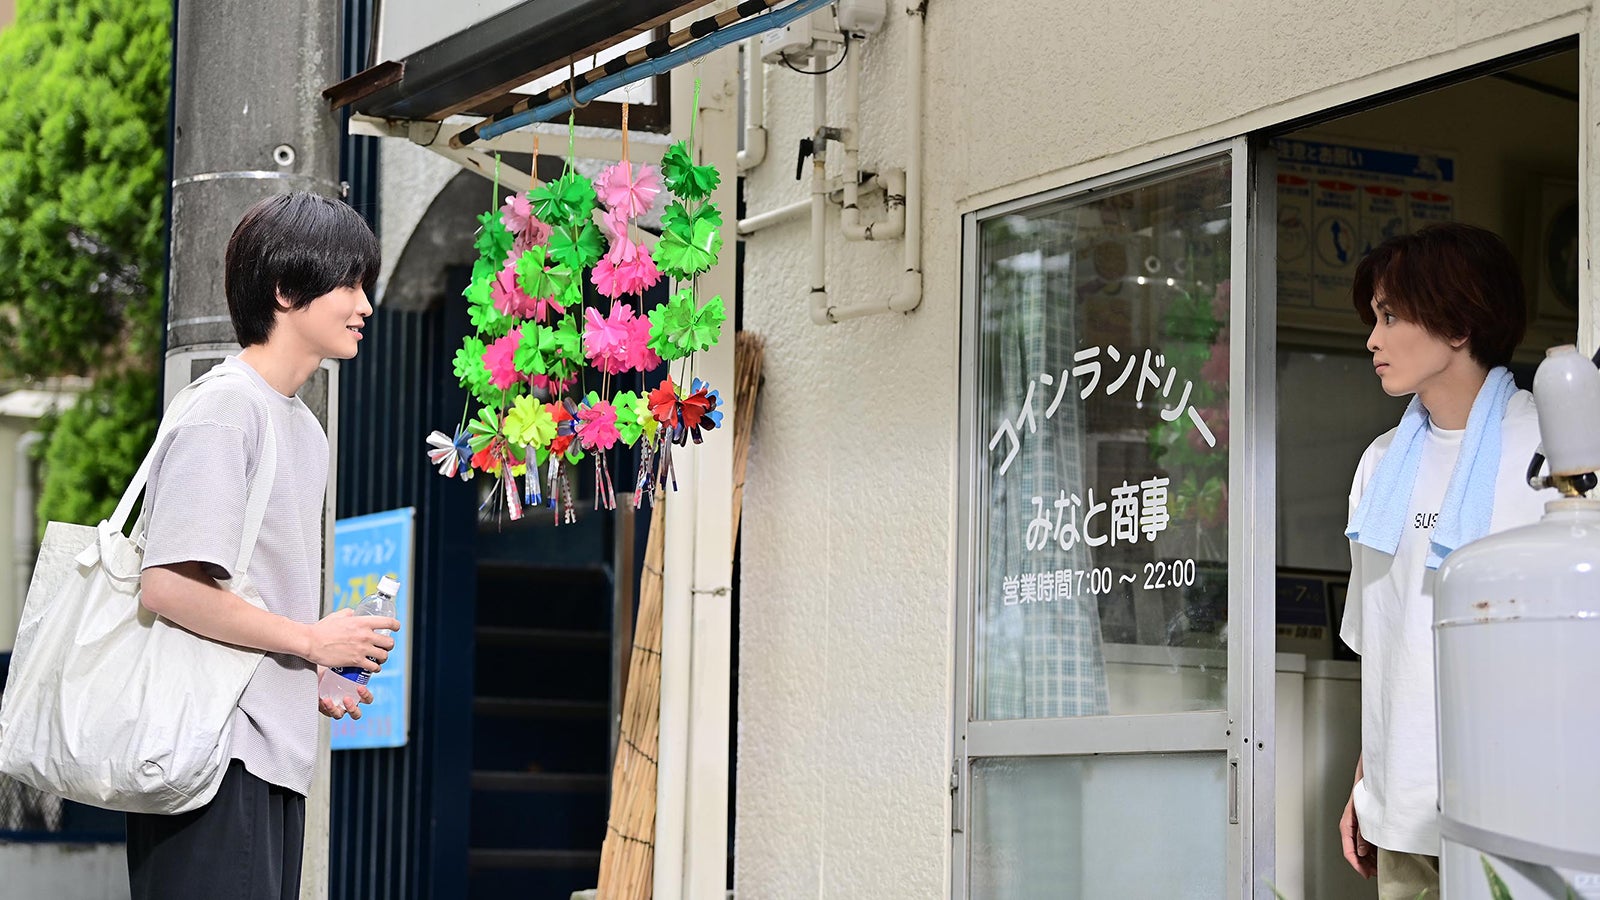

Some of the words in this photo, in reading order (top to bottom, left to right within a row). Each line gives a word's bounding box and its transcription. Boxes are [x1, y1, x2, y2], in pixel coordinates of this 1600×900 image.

[989, 344, 1217, 476] コインランドリー
[1025, 476, 1170, 551] みなと商事
[1143, 558, 1196, 590] 22:00
